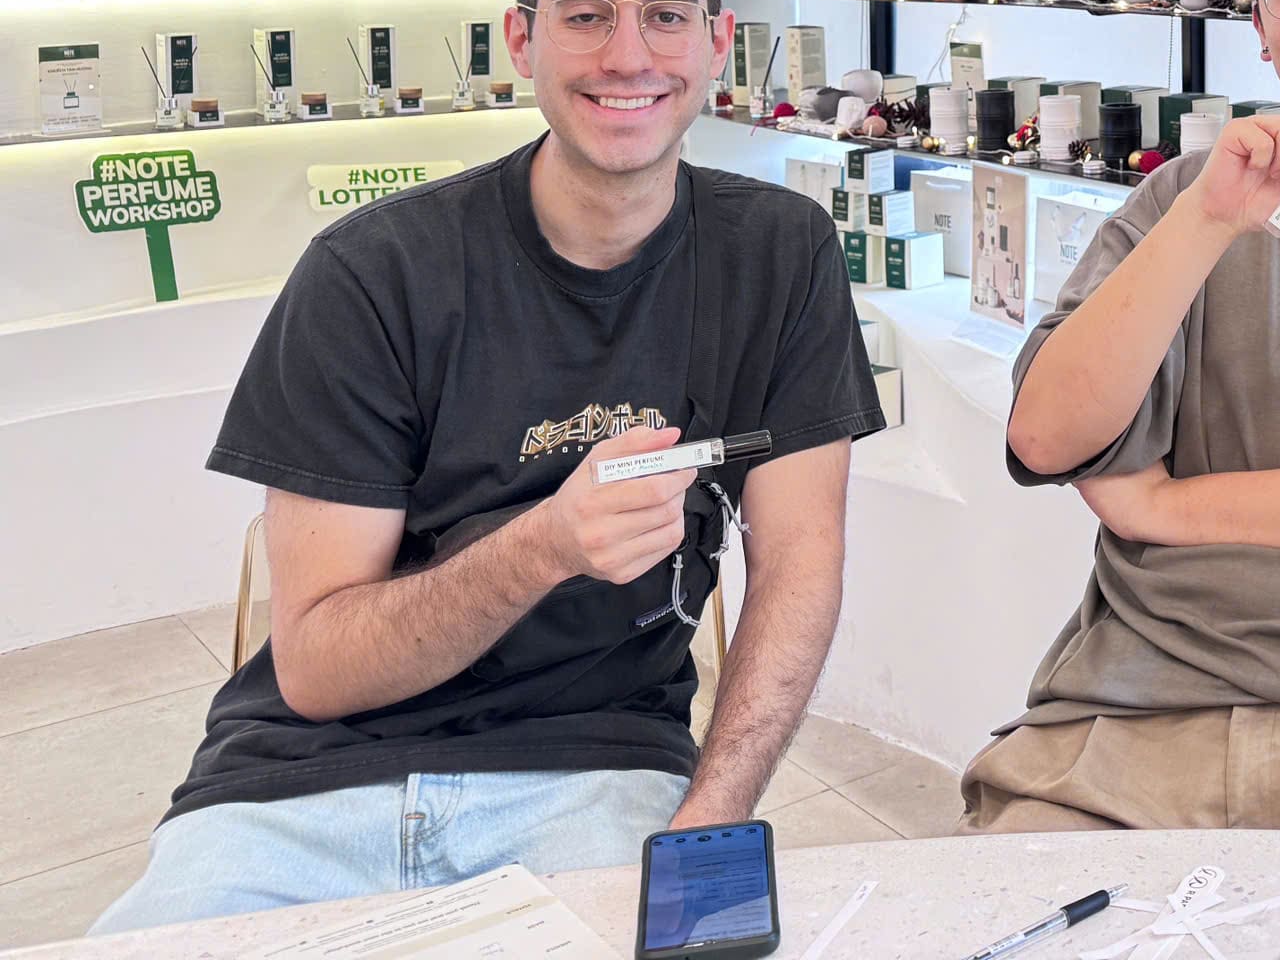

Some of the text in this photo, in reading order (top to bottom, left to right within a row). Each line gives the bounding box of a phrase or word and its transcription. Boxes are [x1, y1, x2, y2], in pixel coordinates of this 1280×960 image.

[100, 155, 191, 182] #NOTE
[349, 168, 426, 185] #NOTE
[82, 177, 213, 208] PERFUME
[319, 187, 400, 205] LOTTE
[87, 199, 215, 227] WORKSHOP
[934, 213, 952, 228] NOTE
[1059, 244, 1078, 262] NOTE
[617, 461, 633, 469] MINI
[635, 455, 664, 465] PERFUME
